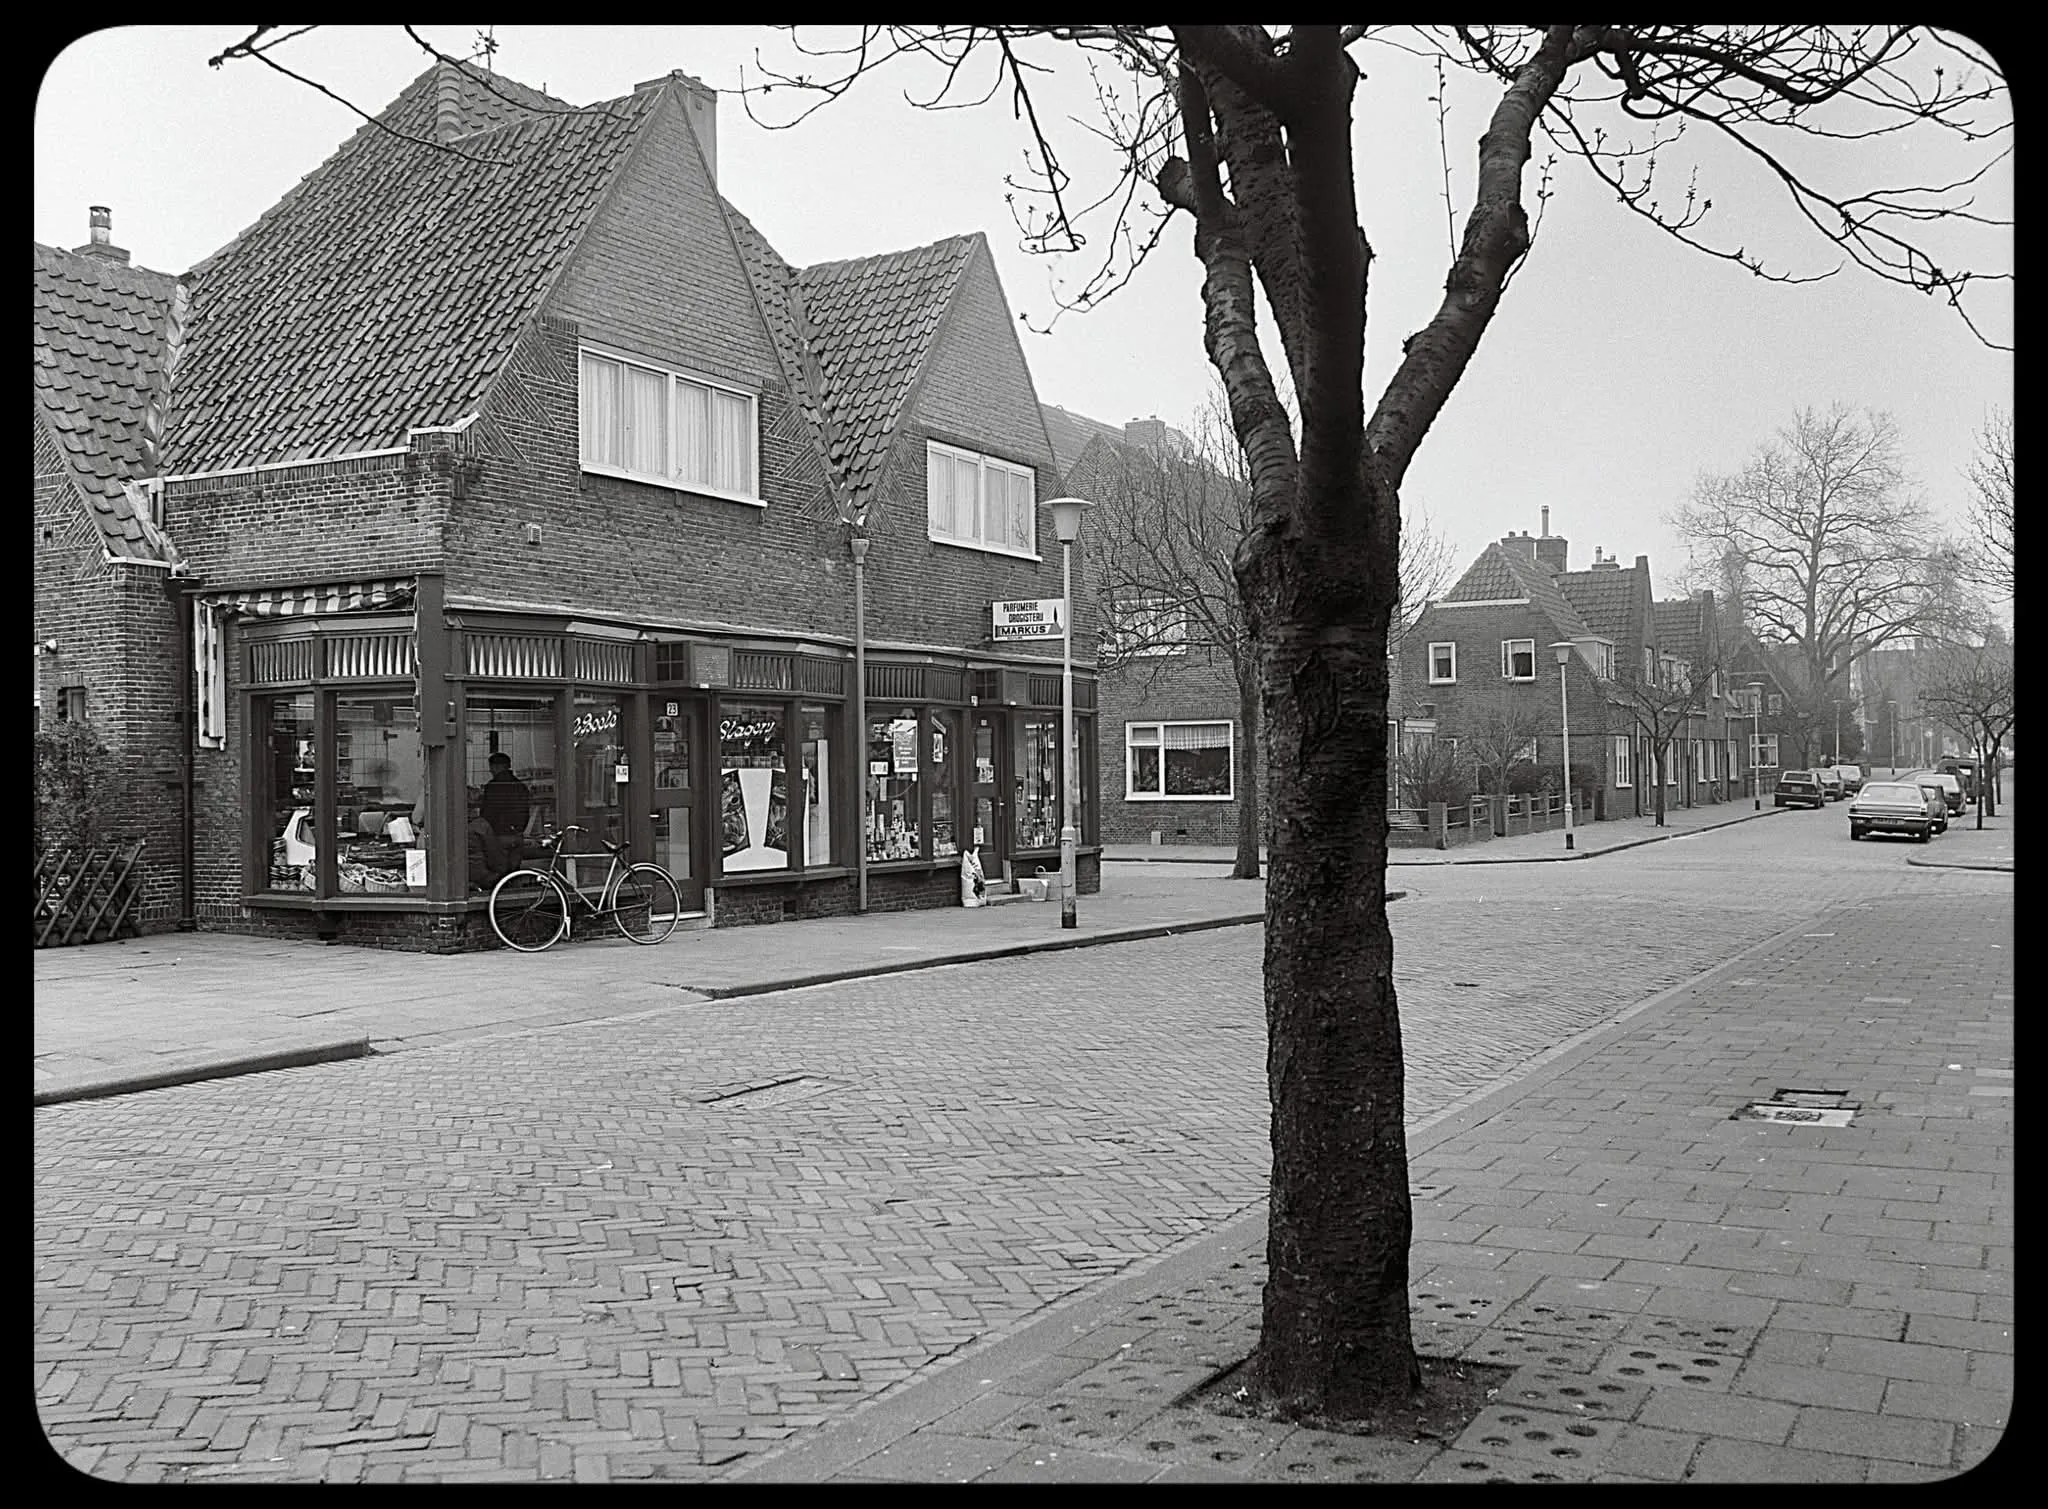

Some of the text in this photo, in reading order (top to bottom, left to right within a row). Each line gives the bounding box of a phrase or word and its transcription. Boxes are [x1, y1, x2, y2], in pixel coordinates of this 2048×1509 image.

[1003, 602, 1039, 613] PARFUMERIE
[1001, 625, 1046, 635] MARKUS
[668, 703, 678, 715] 23
[719, 720, 776, 747] Slagery
